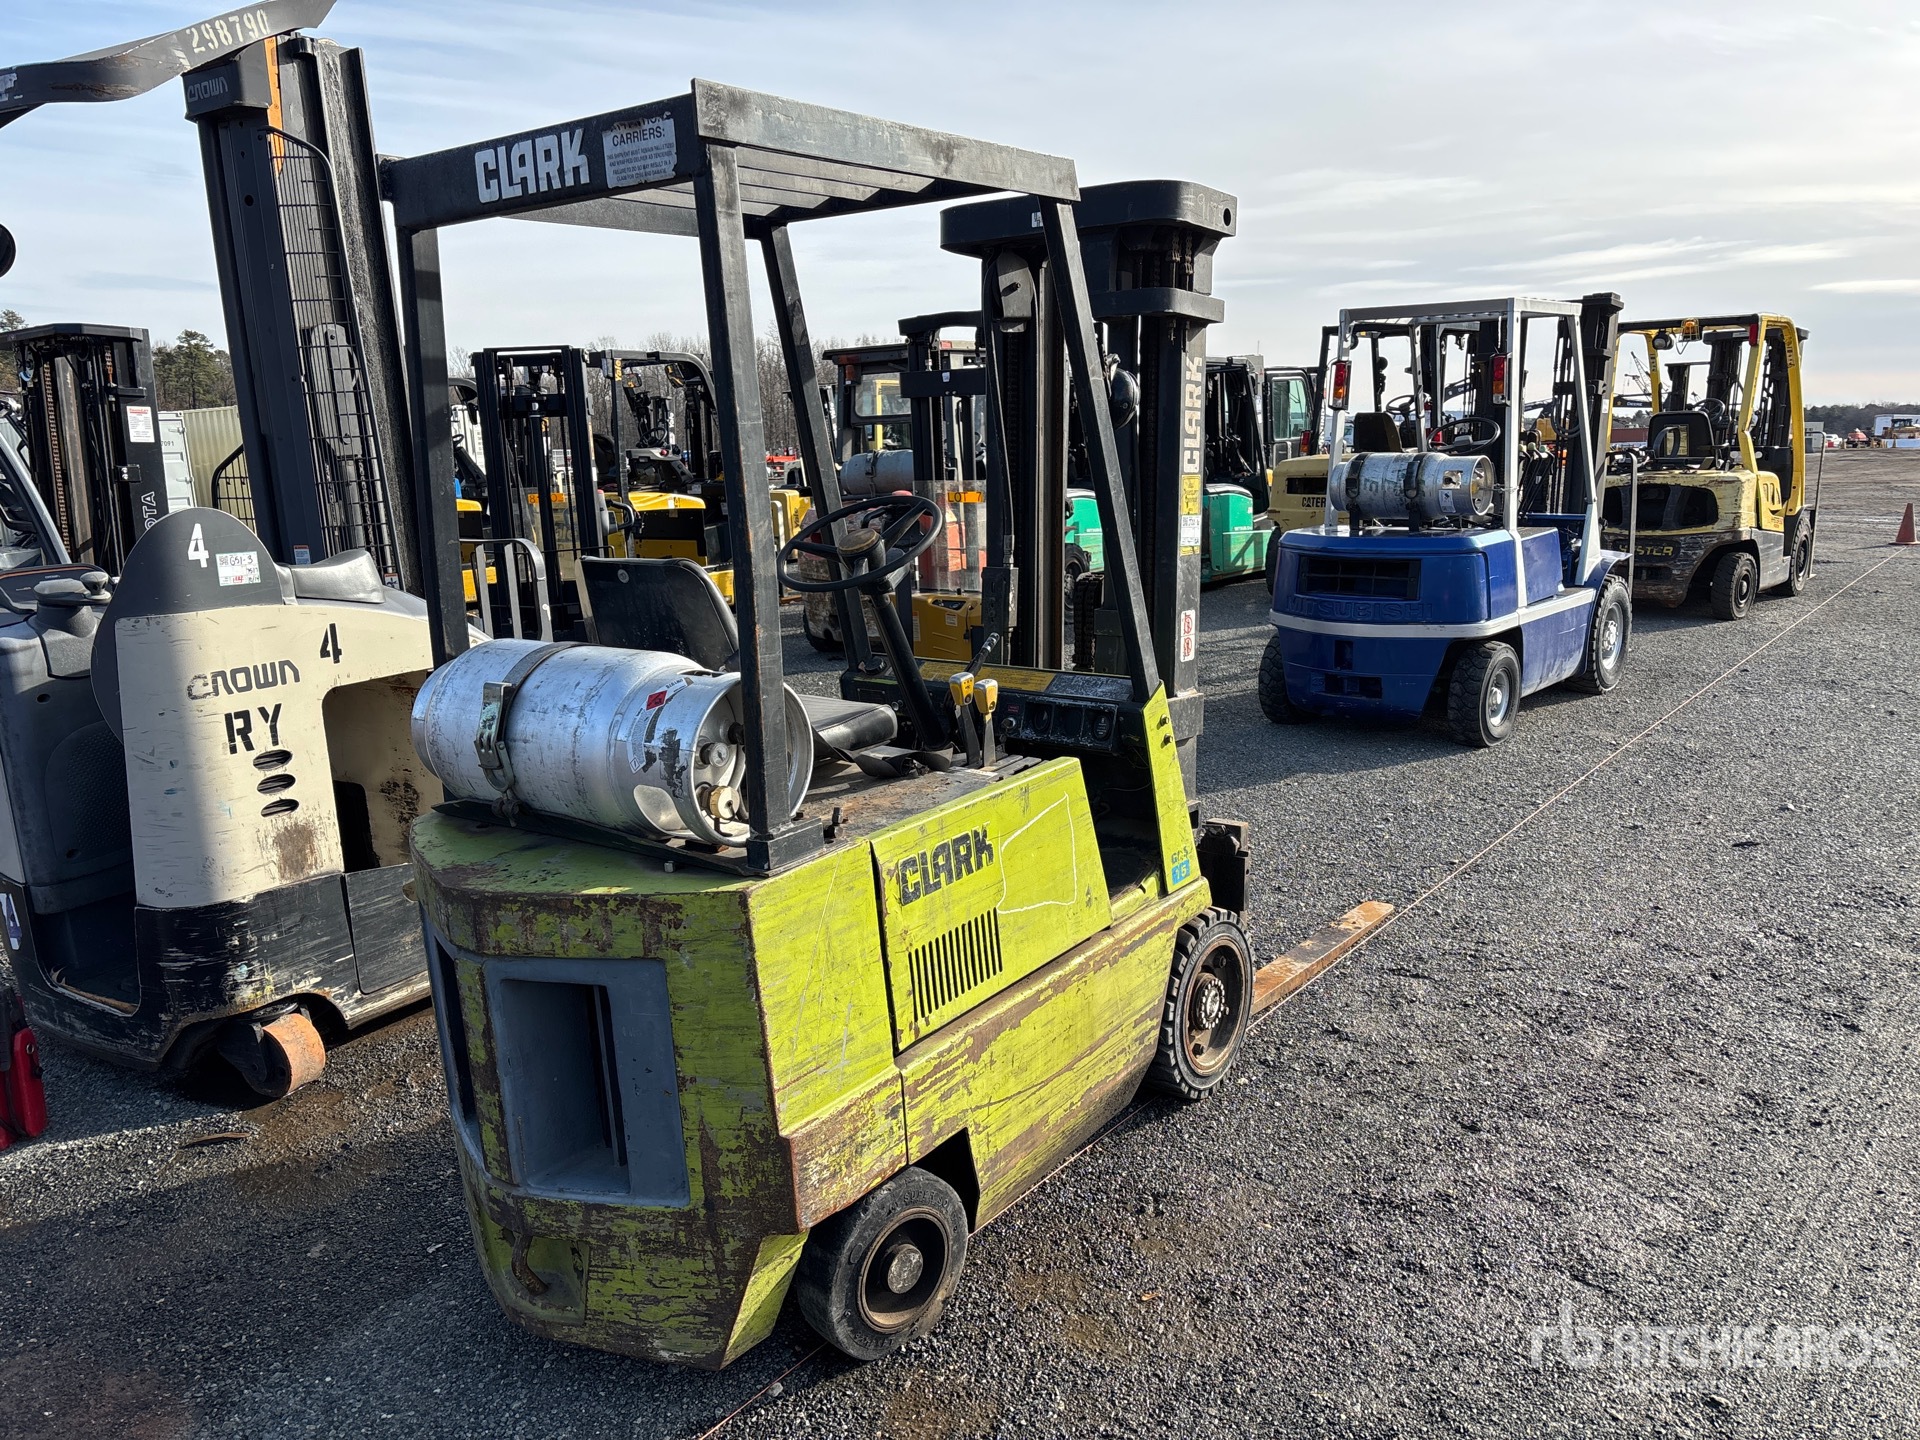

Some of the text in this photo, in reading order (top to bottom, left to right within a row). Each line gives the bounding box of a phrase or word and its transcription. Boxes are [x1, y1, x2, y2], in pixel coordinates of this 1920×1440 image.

[186, 9, 270, 54] 298790
[612, 125, 666, 147] CARRIERS:
[475, 128, 590, 204] CLARK
[1183, 356, 1202, 473] CLARK
[947, 491, 968, 503] LOT
[187, 523, 210, 568] 4
[1618, 544, 1673, 556] HSTER
[1286, 597, 1432, 620] MITSUBISHI
[320, 622, 343, 664] 4
[187, 659, 301, 700] CROWN
[224, 703, 282, 755] RY
[898, 823, 994, 907] CLARK
